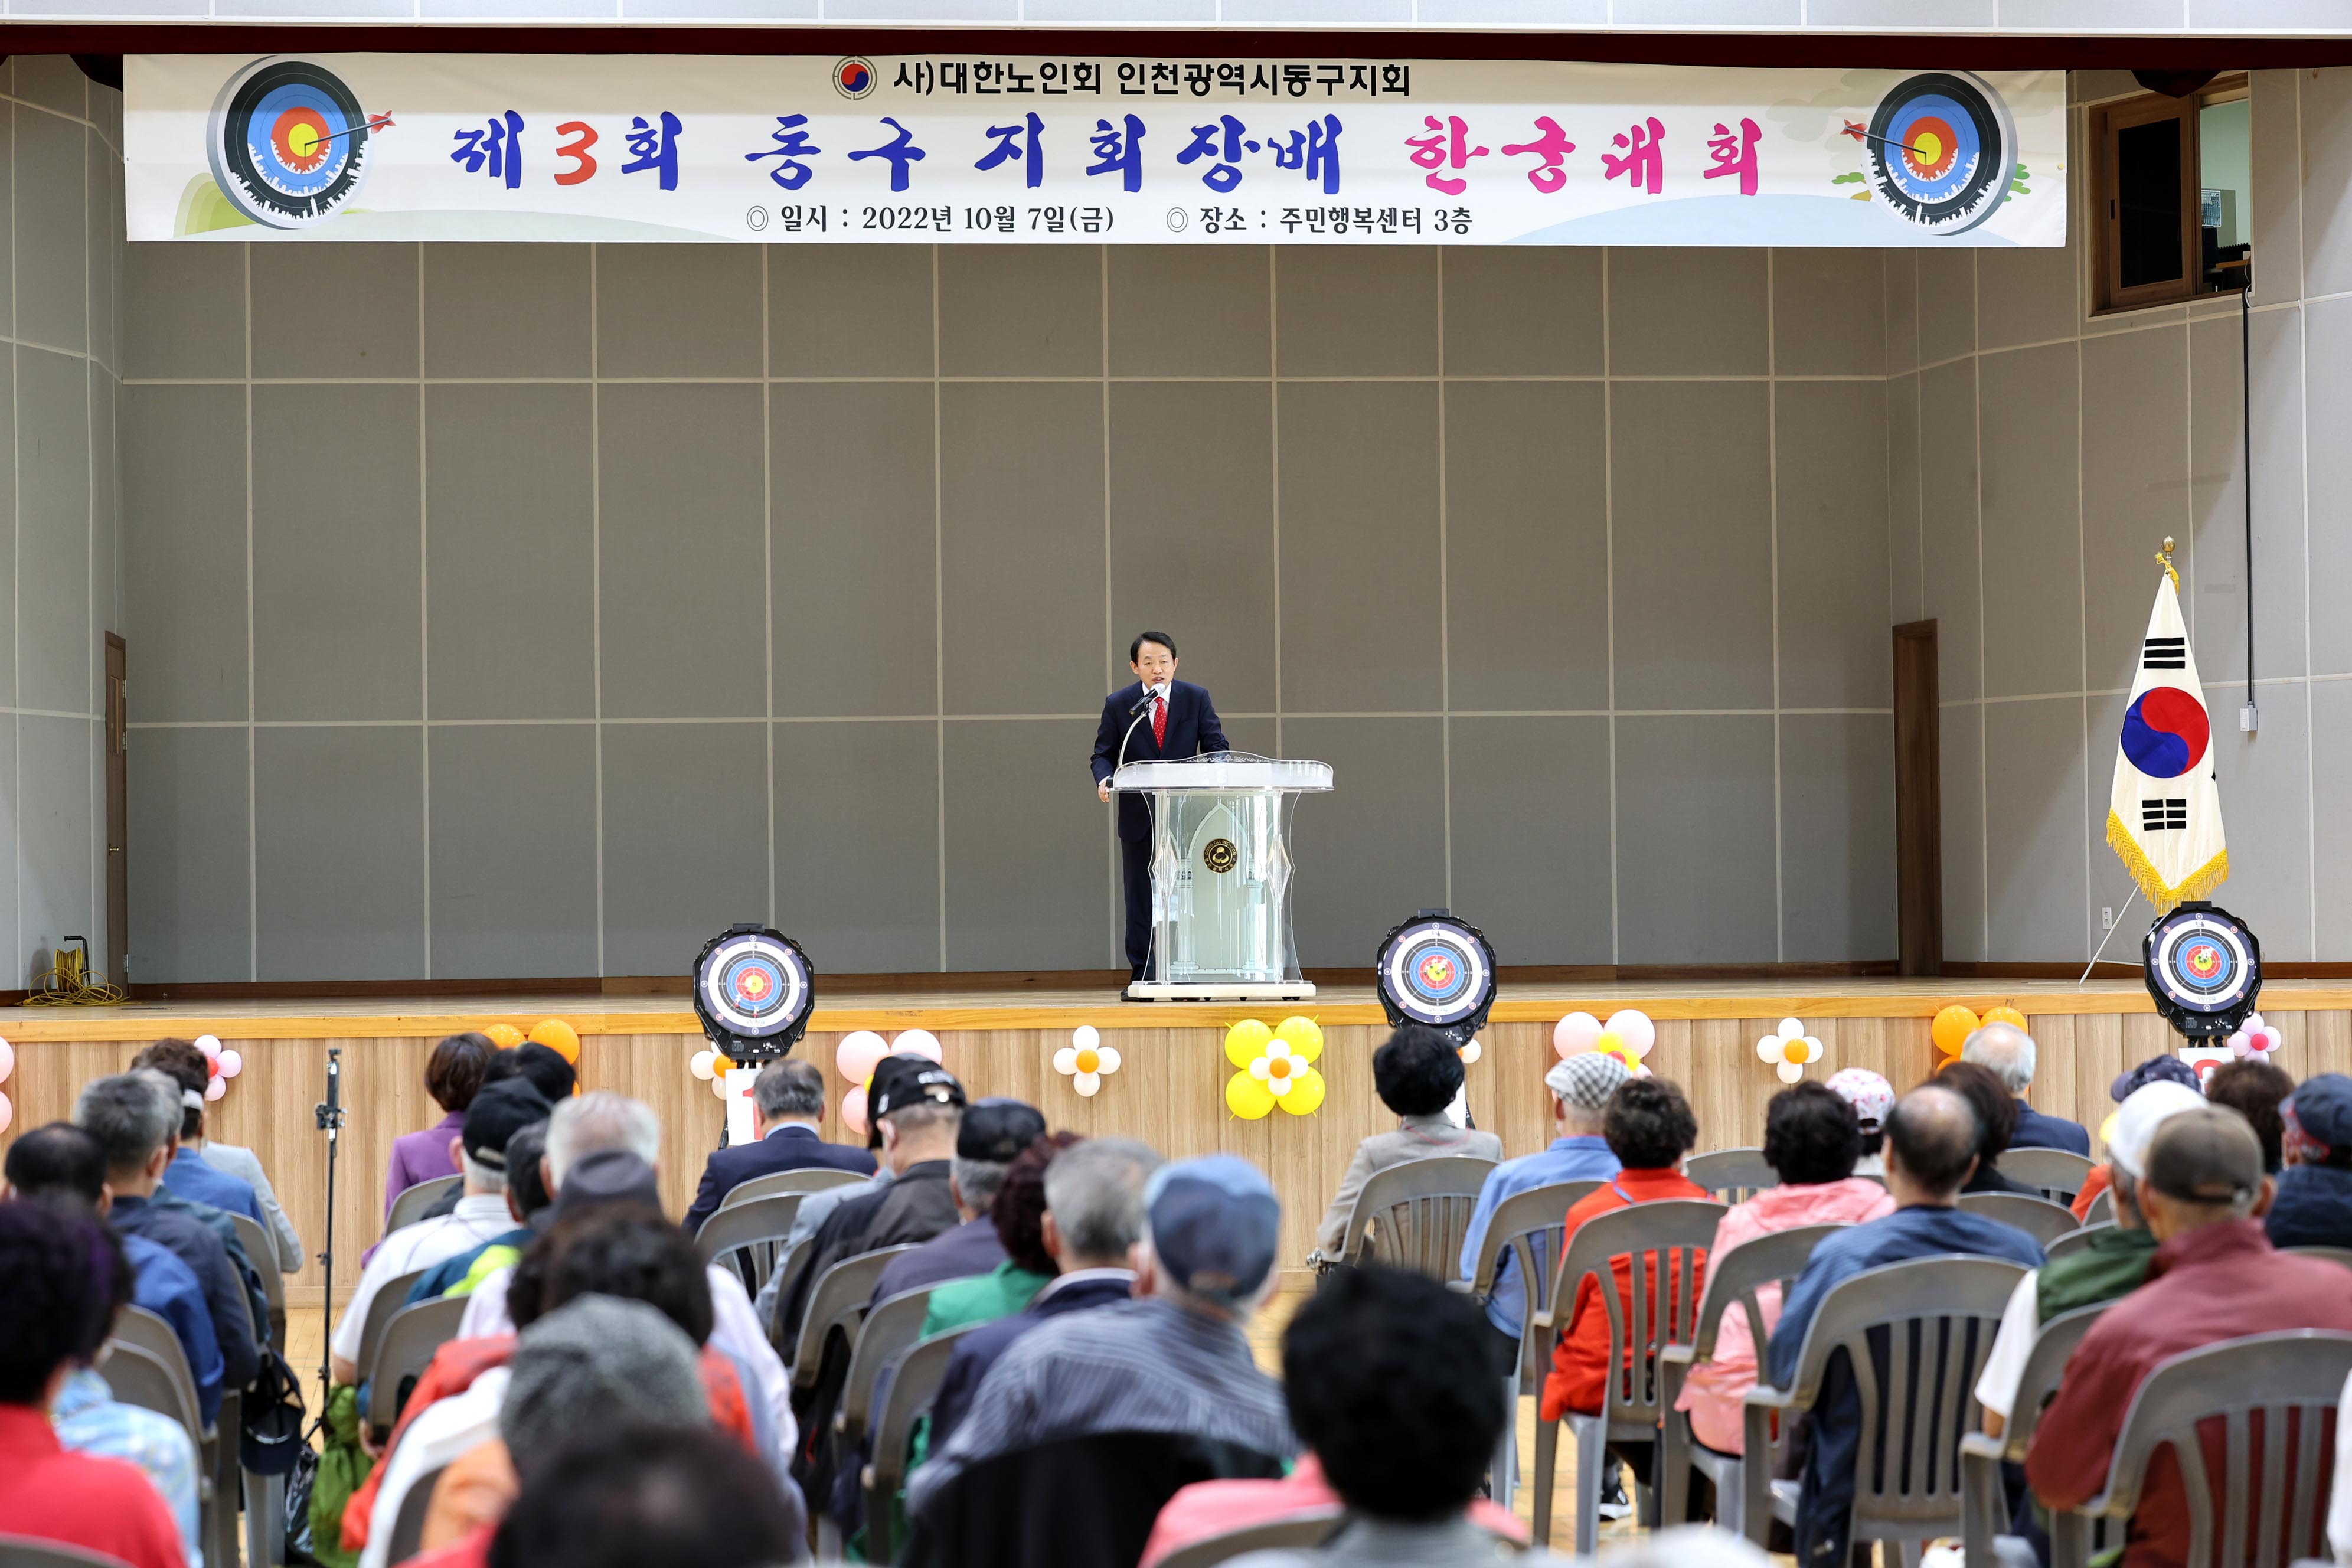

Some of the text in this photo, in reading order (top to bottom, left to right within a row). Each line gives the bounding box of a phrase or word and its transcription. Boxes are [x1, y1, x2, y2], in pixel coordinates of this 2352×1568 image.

[893, 60, 1410, 97] 사)대한노인회 인천광역시동구지회
[450, 110, 1762, 196] 제3회 동구 지회장배 한궁대회
[780, 205, 827, 232] 일시
[862, 206, 952, 232] 2022년
[965, 206, 1015, 233] 10월
[1027, 206, 1115, 233] 7일(금)
[1200, 207, 1247, 234] 장소
[1279, 207, 1422, 234] 주민행복센터
[1434, 207, 1474, 234] 3층
[1205, 843, 1214, 855] DONG
